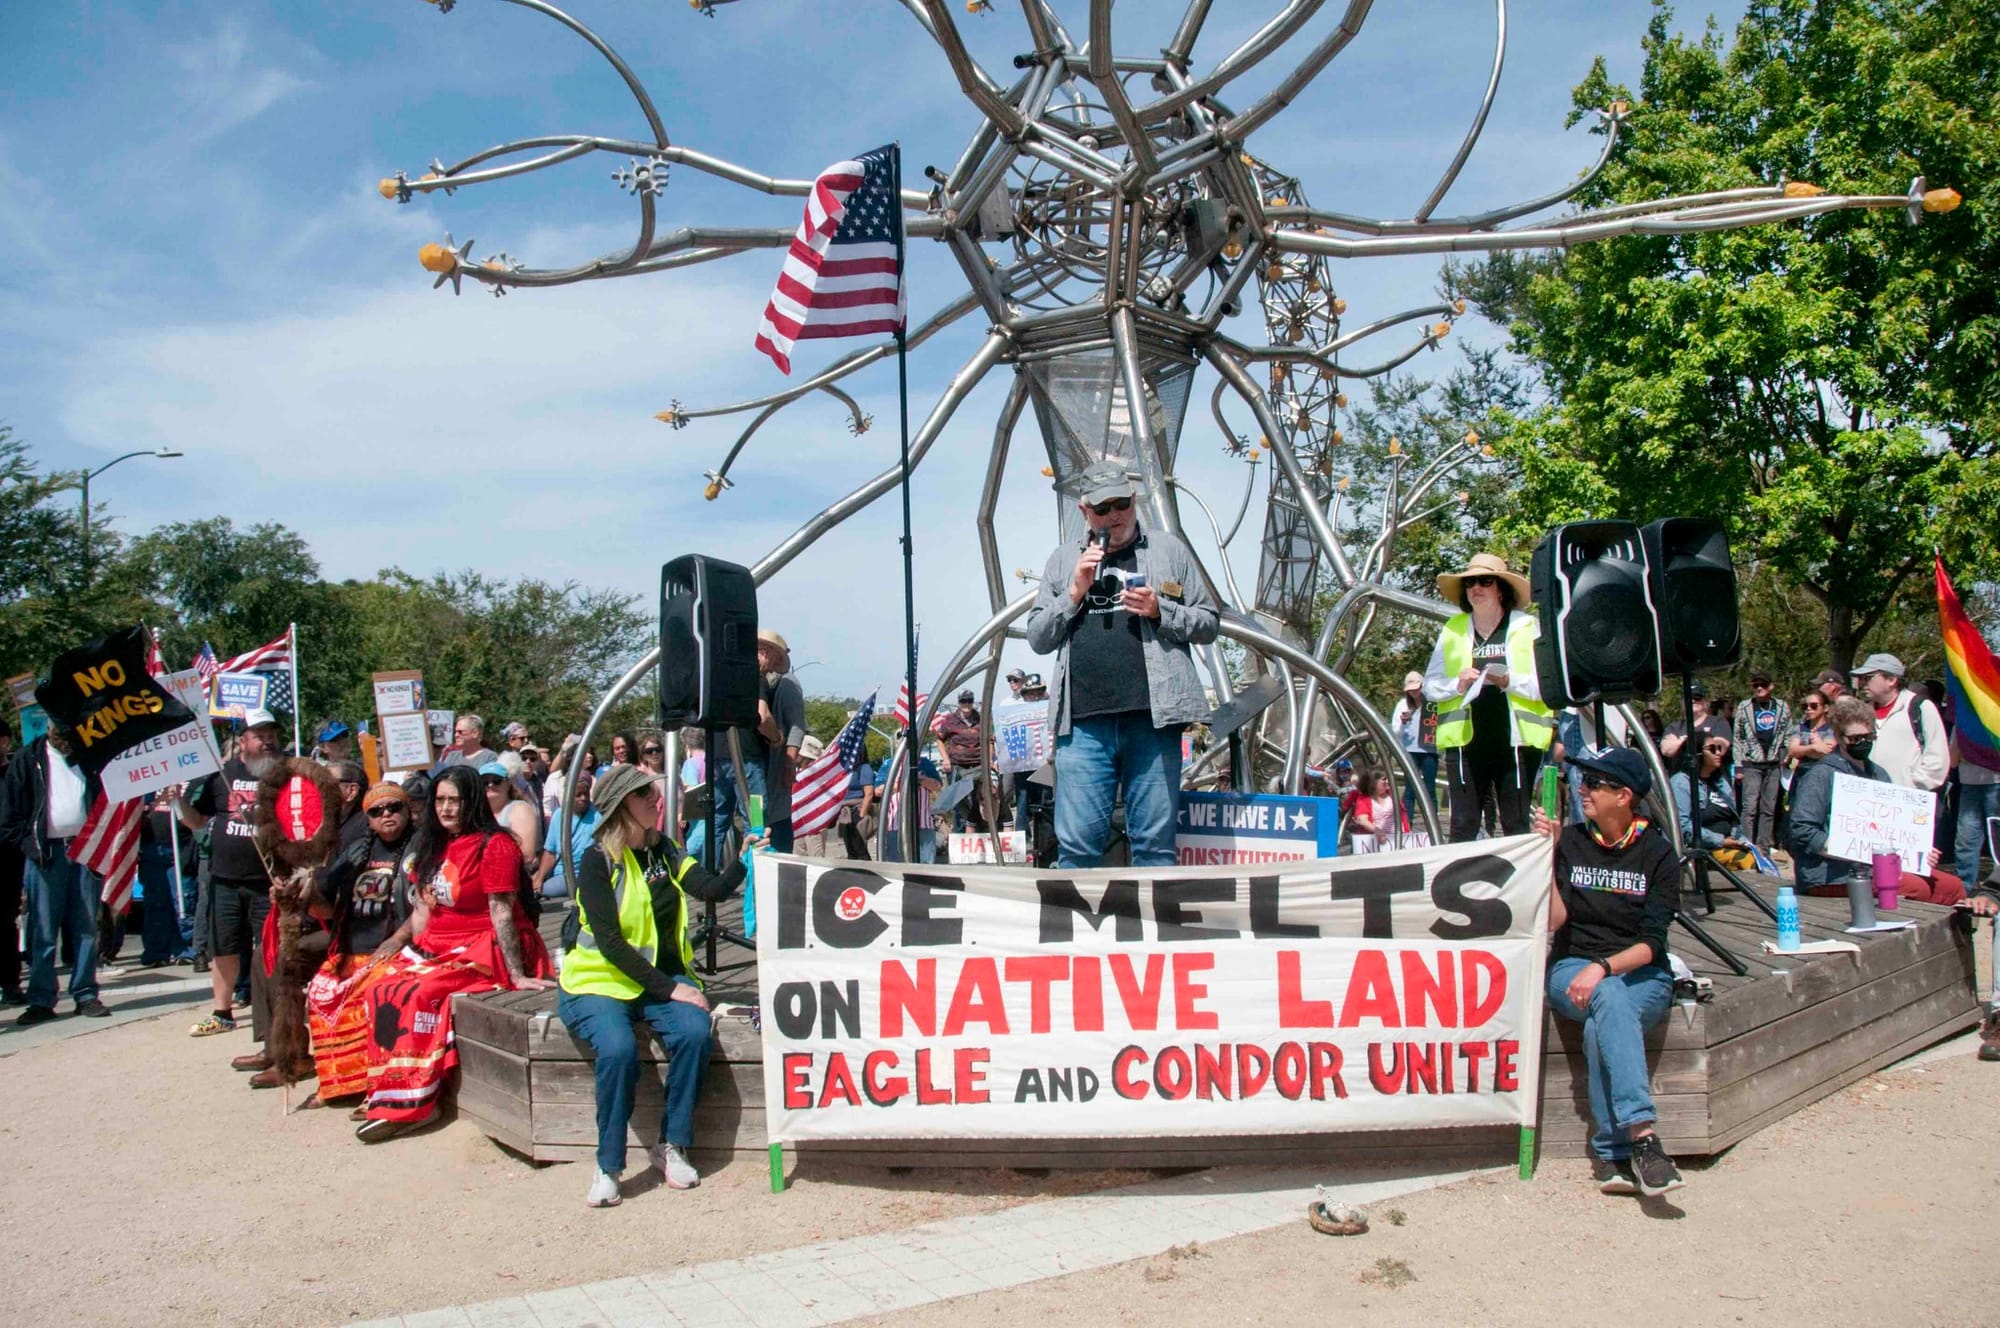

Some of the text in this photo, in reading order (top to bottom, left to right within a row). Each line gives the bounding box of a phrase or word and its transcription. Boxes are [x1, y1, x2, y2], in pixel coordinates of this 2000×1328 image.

[72, 659, 126, 698] NO
[222, 683, 258, 697] SAVE
[76, 689, 164, 749] KINGS
[111, 726, 209, 761] UZZLE DOGE
[128, 752, 200, 783] MELT ICE
[1189, 803, 1287, 832] WE HAVE A
[1856, 800, 1902, 822] STOP
[960, 836, 1012, 854] HAE
[1035, 854, 1516, 944] MELTS
[1571, 873, 1646, 892] INDIVISIBLE
[773, 950, 1507, 1039] ON NATIVE LAND
[783, 1039, 1520, 1110] EAGLE AND CONDOR UNITE
